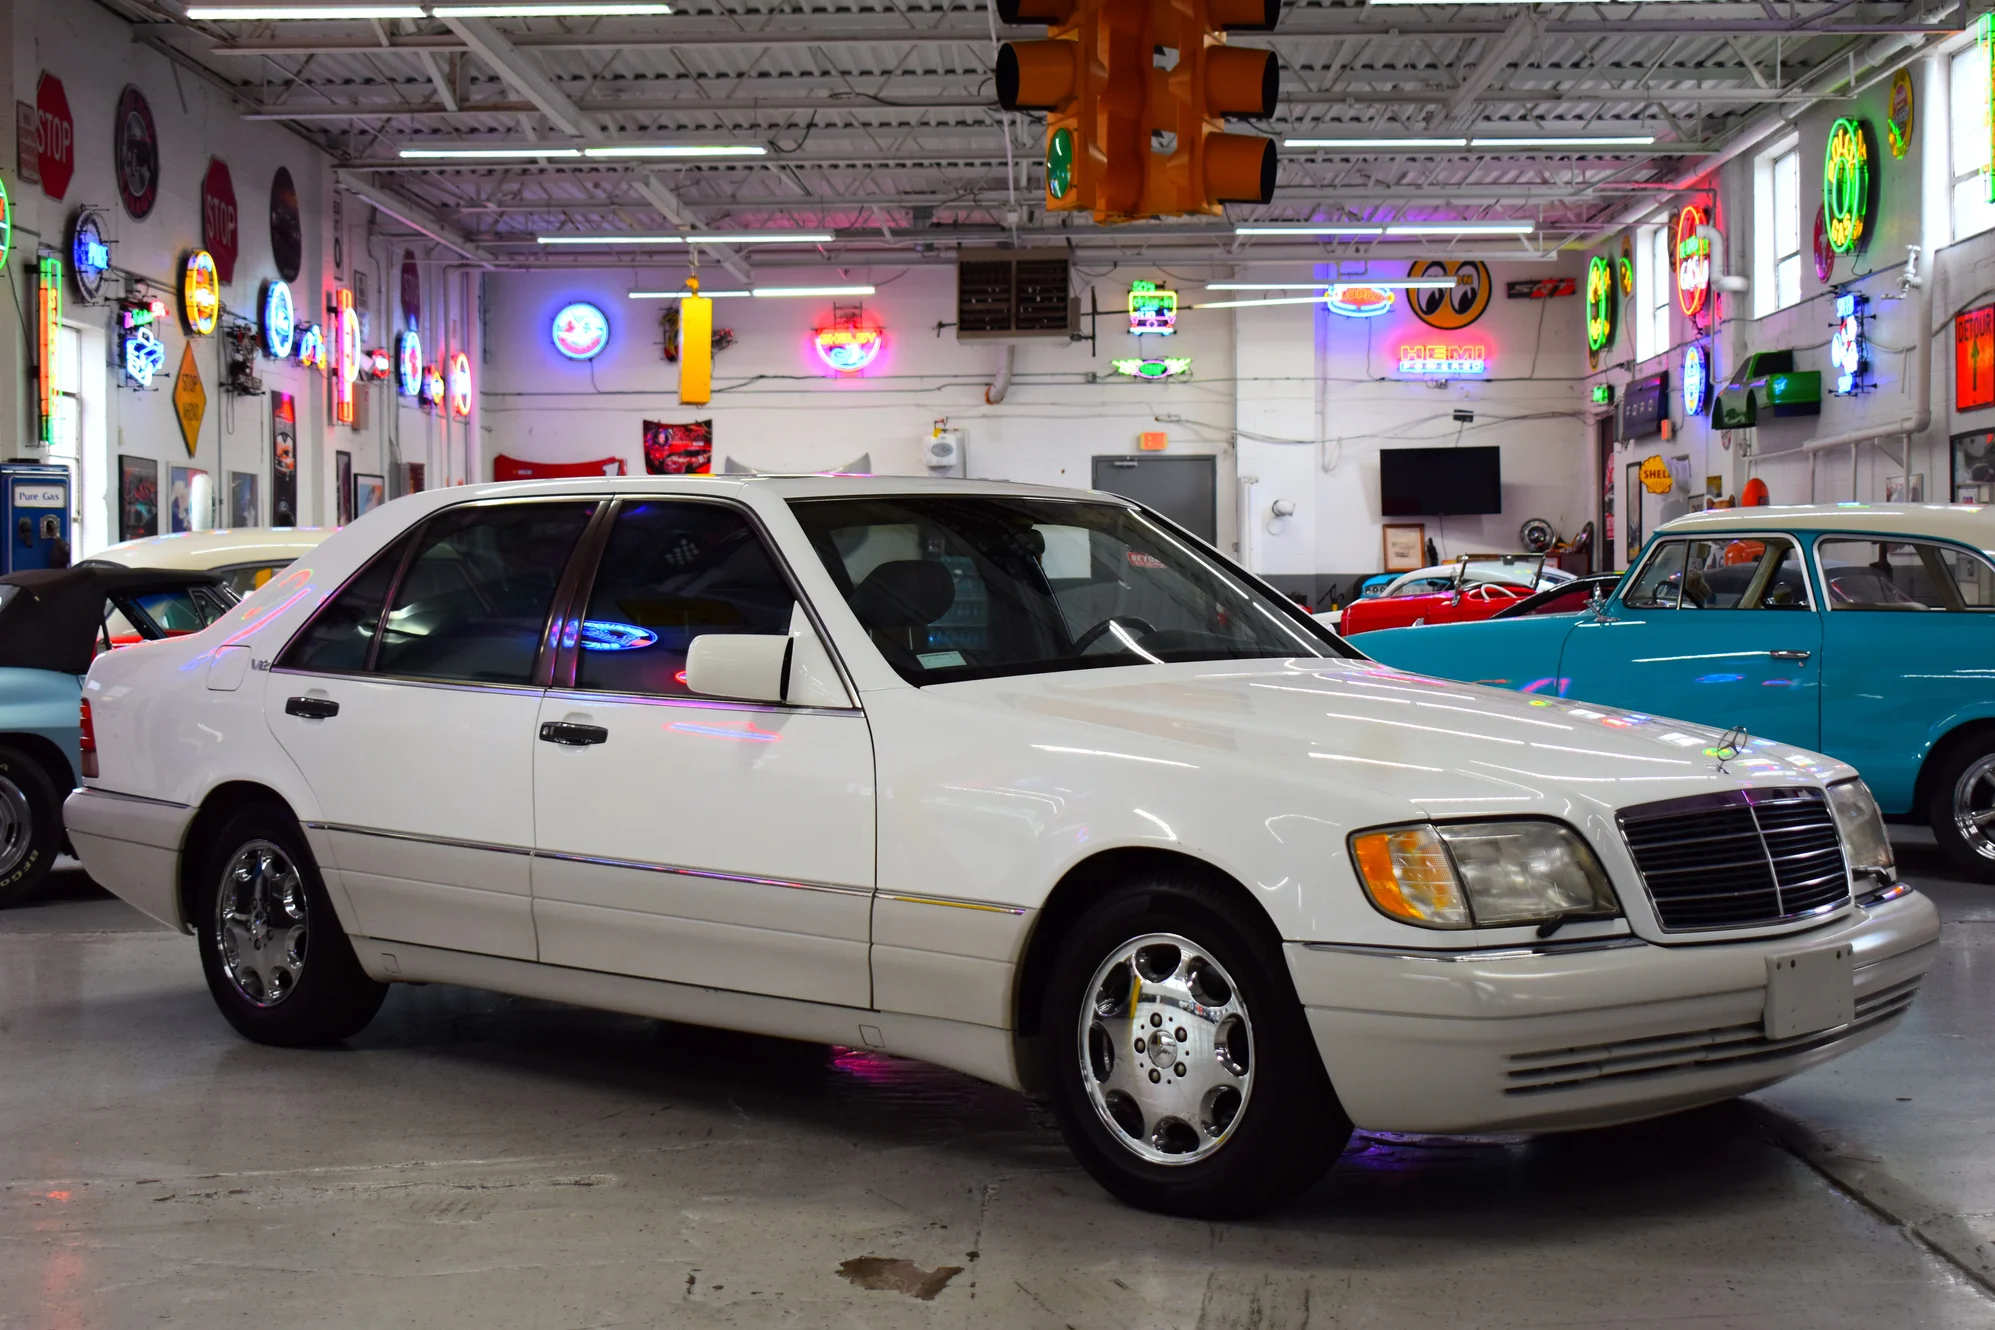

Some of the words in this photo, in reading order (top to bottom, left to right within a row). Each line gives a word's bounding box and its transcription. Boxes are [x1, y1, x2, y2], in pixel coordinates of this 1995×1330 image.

[37, 107, 72, 163] STOP
[206, 194, 236, 249] STOP
[1957, 312, 1992, 343] DETOUR
[1400, 345, 1485, 361] HEMI
[19, 492, 39, 501] Pure
[42, 492, 60, 501] Gas
